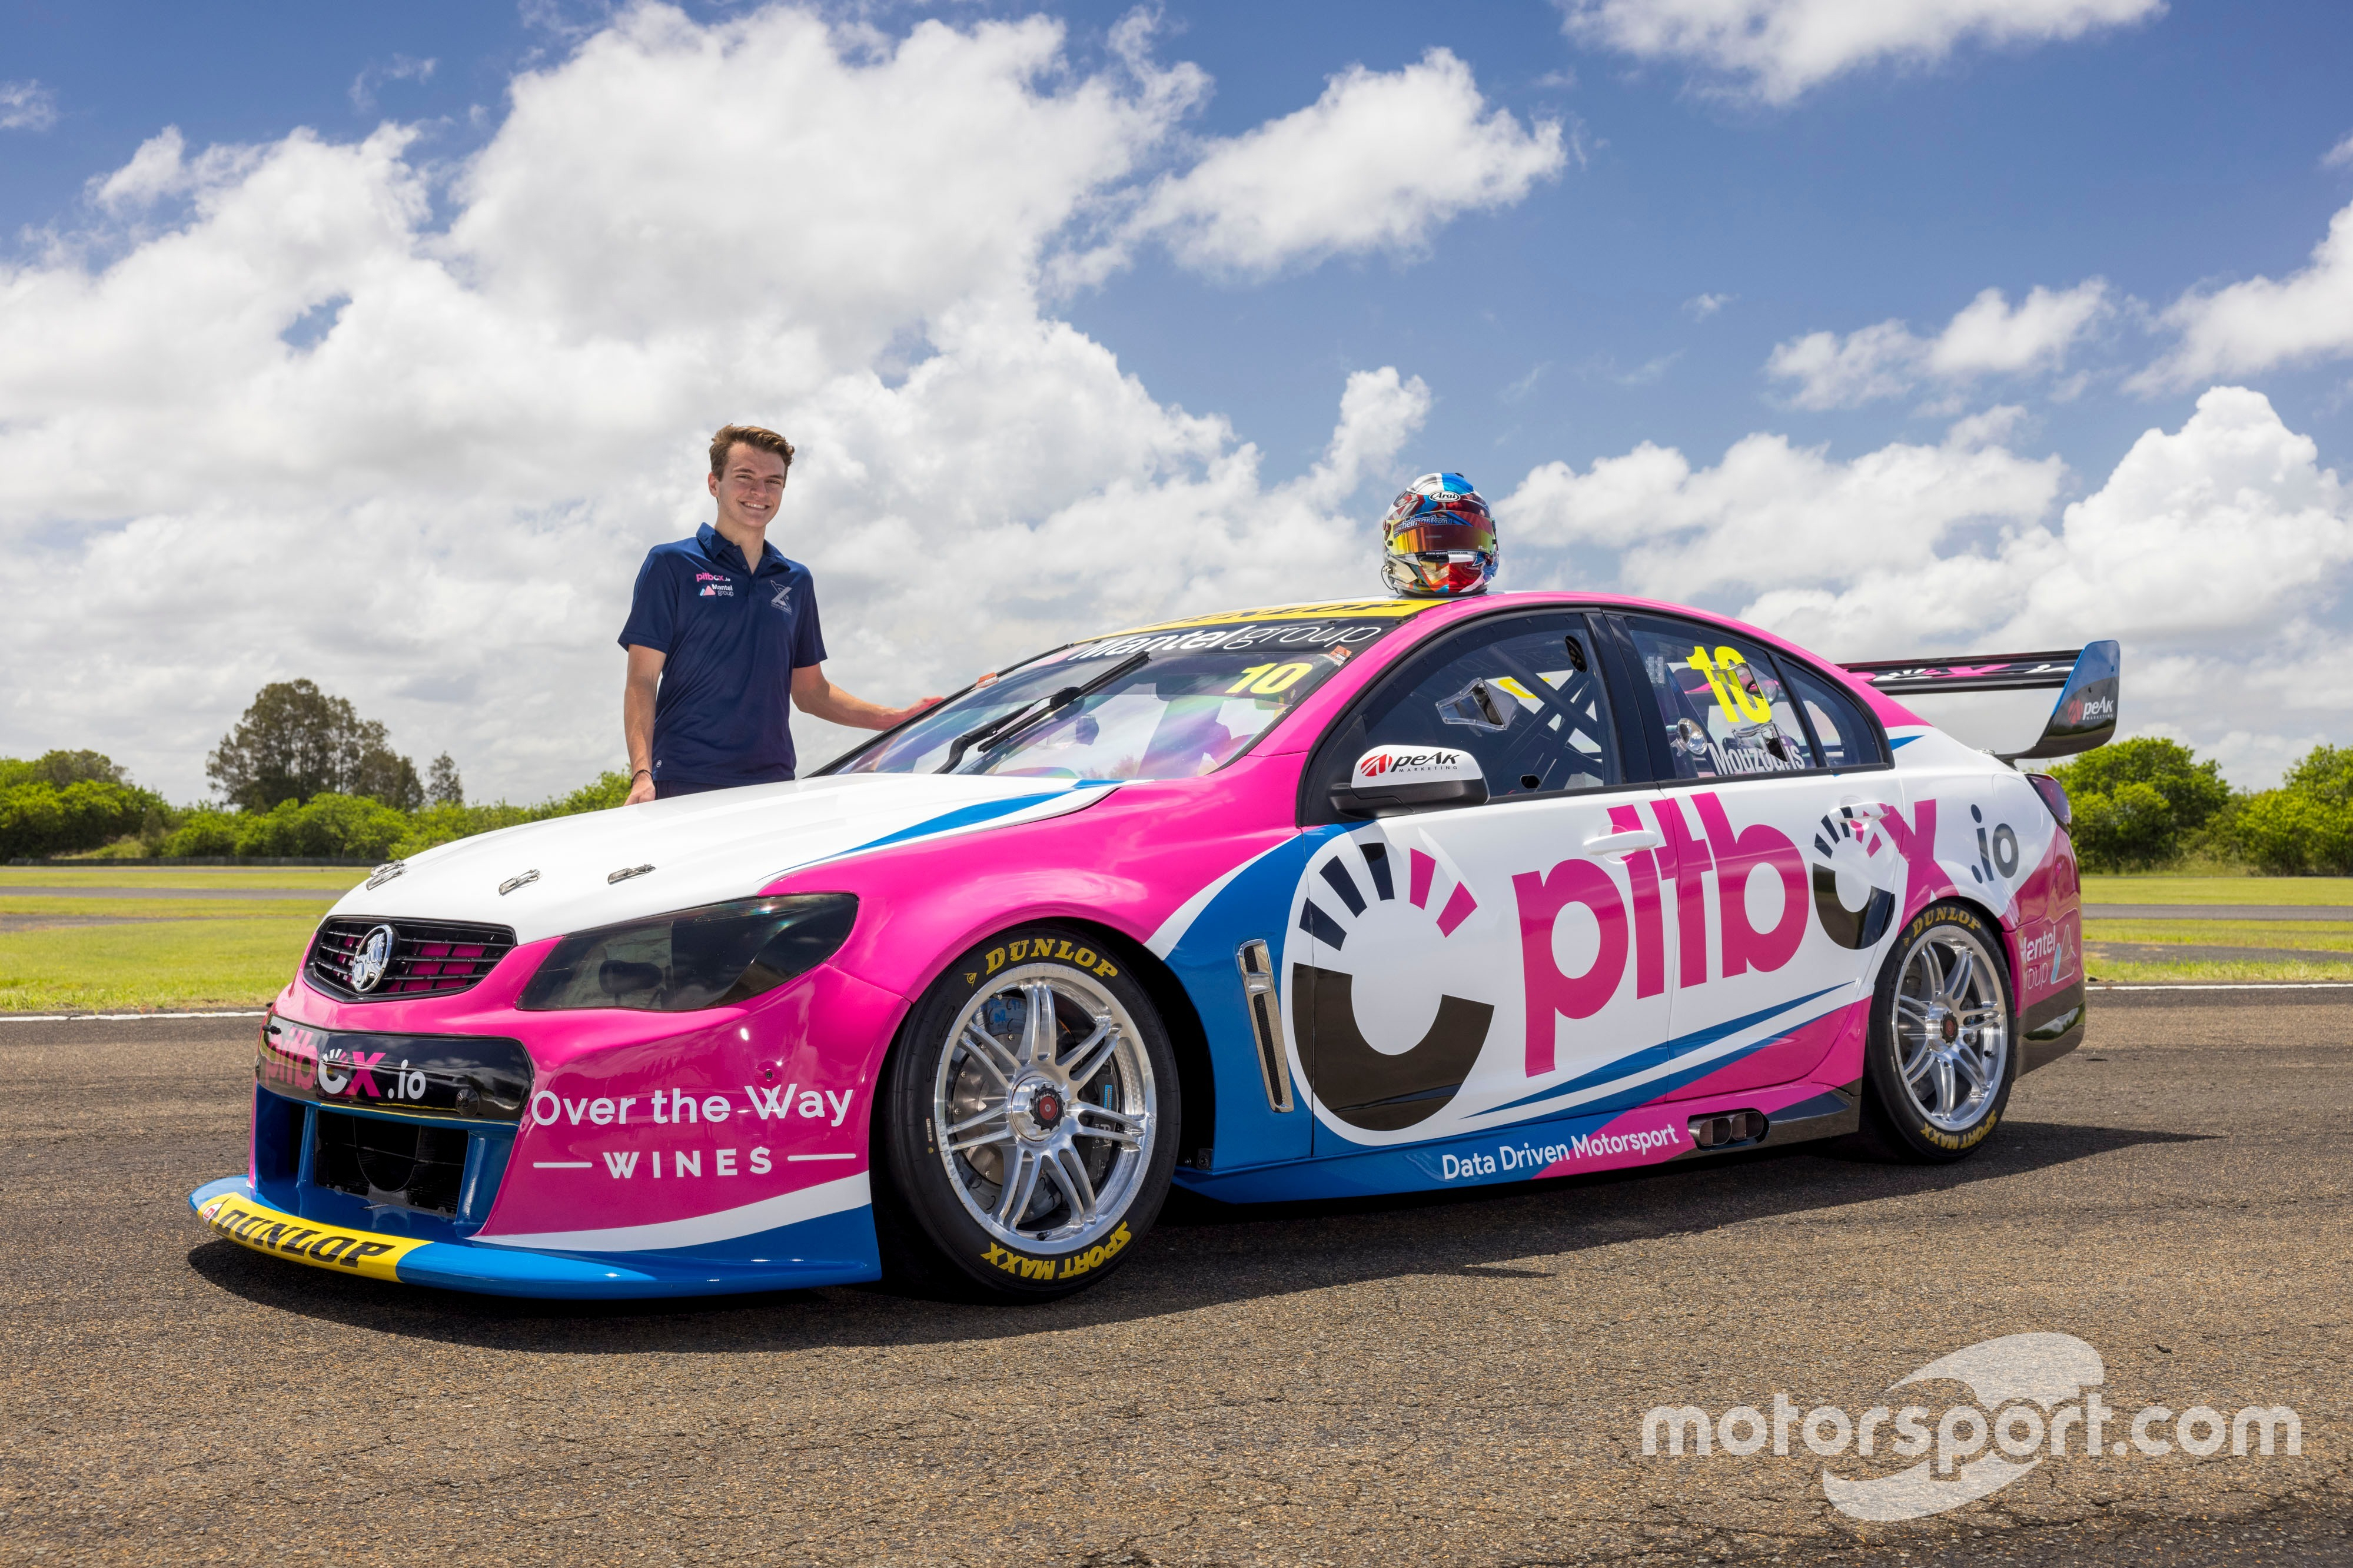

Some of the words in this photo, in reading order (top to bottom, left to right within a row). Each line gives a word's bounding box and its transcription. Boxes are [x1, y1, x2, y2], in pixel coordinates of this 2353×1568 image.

[1068, 625, 1247, 660] Mantel
[1223, 626, 1381, 650] group
[1225, 663, 1313, 694] 10
[1686, 646, 1772, 723] 10
[1912, 906, 1982, 938] DUNLOP
[985, 938, 1118, 977] DUNLOP
[531, 1090, 636, 1126] Over
[651, 1088, 731, 1124] the
[744, 1083, 854, 1127] Way
[1920, 1121, 1959, 1150] MAXX
[1960, 1109, 1997, 1149] SPORT
[603, 1147, 773, 1179] WINES
[1441, 1152, 1497, 1180] Data
[1499, 1142, 1570, 1171] Driven
[1571, 1124, 1680, 1159] Motorsport
[215, 1208, 396, 1268] DUNLOP
[1058, 1220, 1131, 1280] SPORT
[980, 1241, 1056, 1280] MAXX
